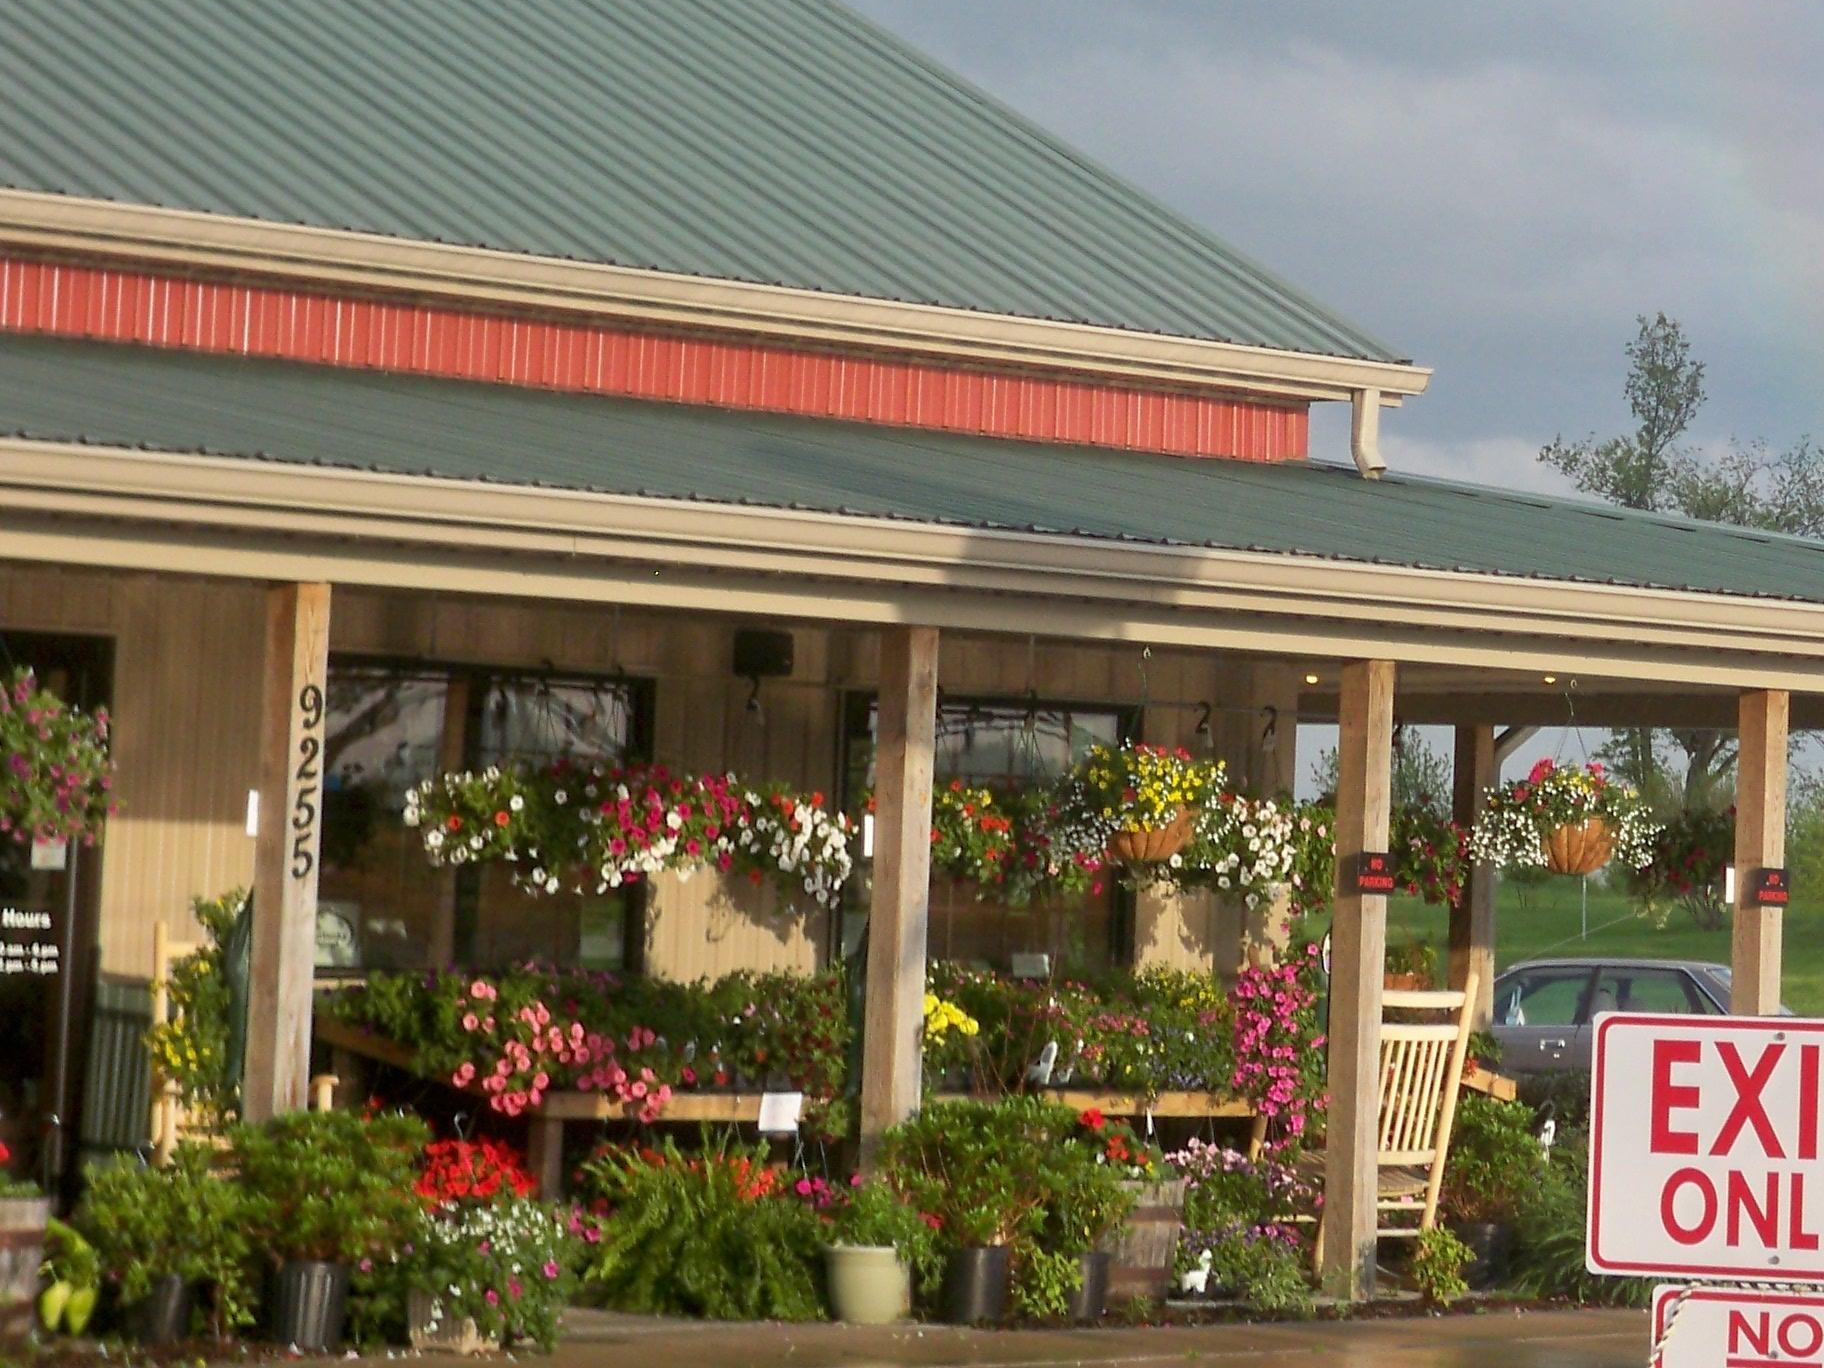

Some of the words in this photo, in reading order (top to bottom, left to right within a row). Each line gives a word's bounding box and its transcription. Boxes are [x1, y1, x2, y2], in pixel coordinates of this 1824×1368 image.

[291, 684, 324, 879] 9255
[1370, 857, 1384, 871] NO
[1358, 875, 1395, 890] PARKING
[1768, 873, 1781, 886] NO
[1758, 889, 1789, 903] PARKING
[2, 907, 51, 929] Hours
[1727, 1310, 1824, 1358] NO
